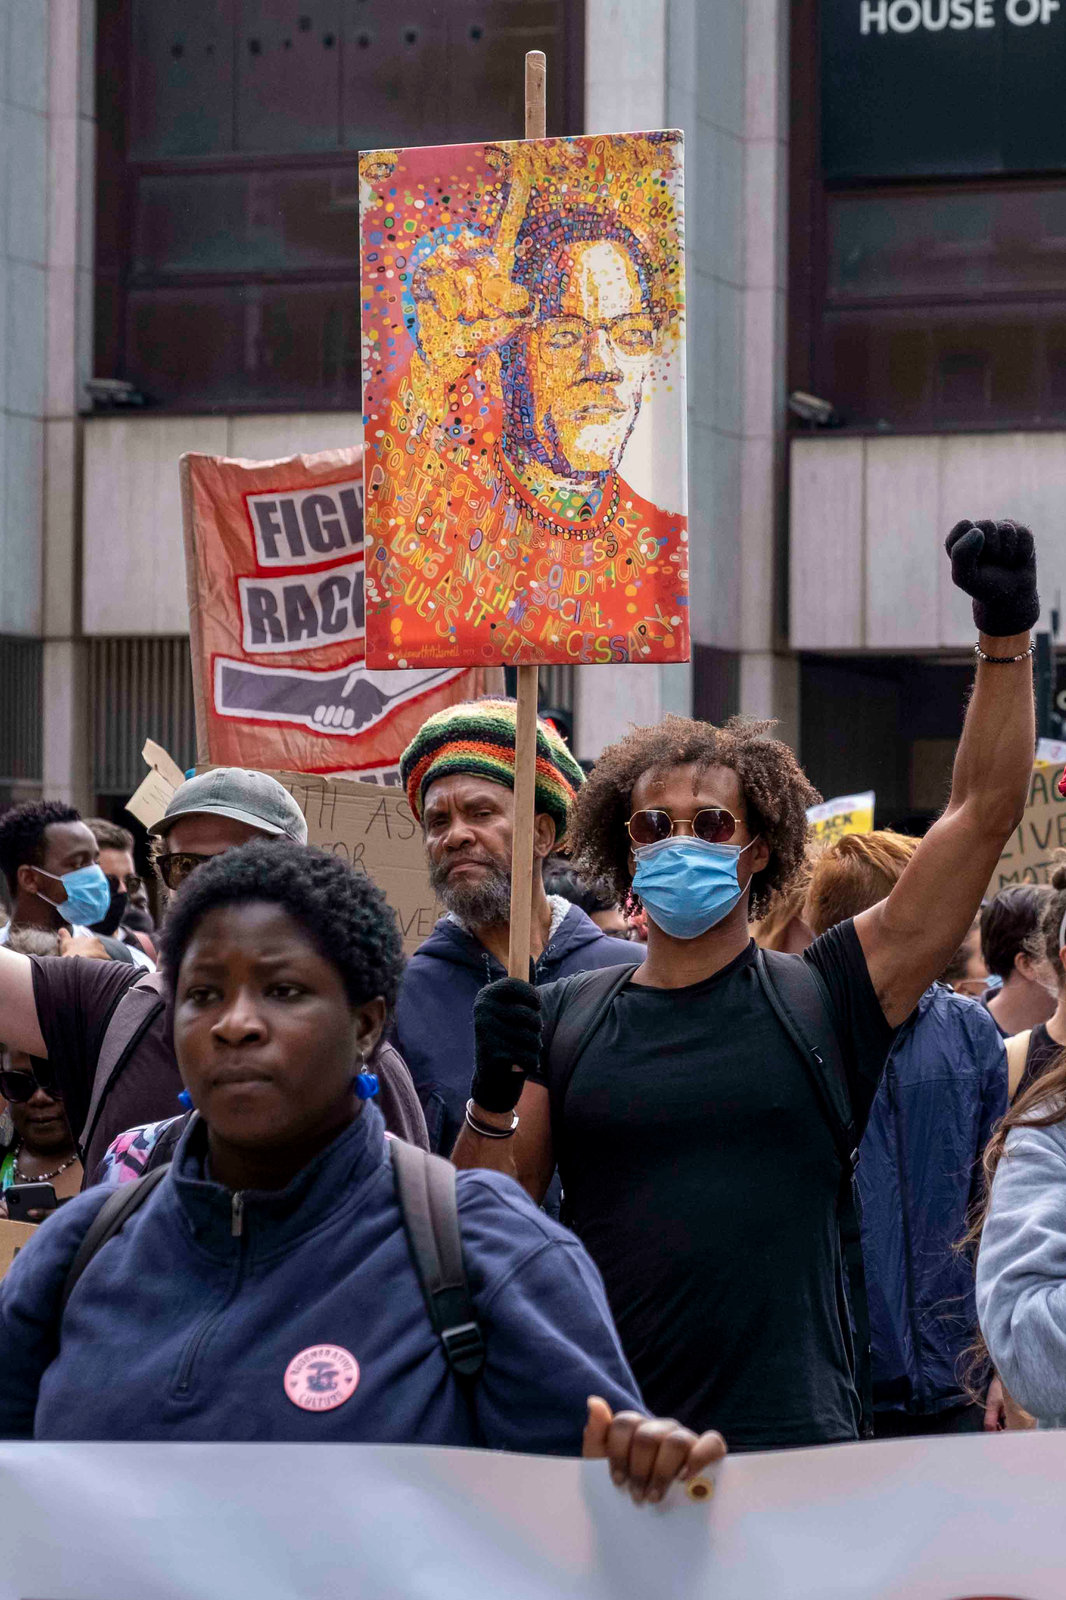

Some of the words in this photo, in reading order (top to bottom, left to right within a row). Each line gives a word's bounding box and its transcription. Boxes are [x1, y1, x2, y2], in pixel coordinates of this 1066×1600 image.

[860, 0, 996, 35] HOUSE
[1005, 0, 1061, 26] OF
[390, 524, 445, 580] LONG
[290, 784, 337, 831] TH
[365, 797, 416, 840] AS
